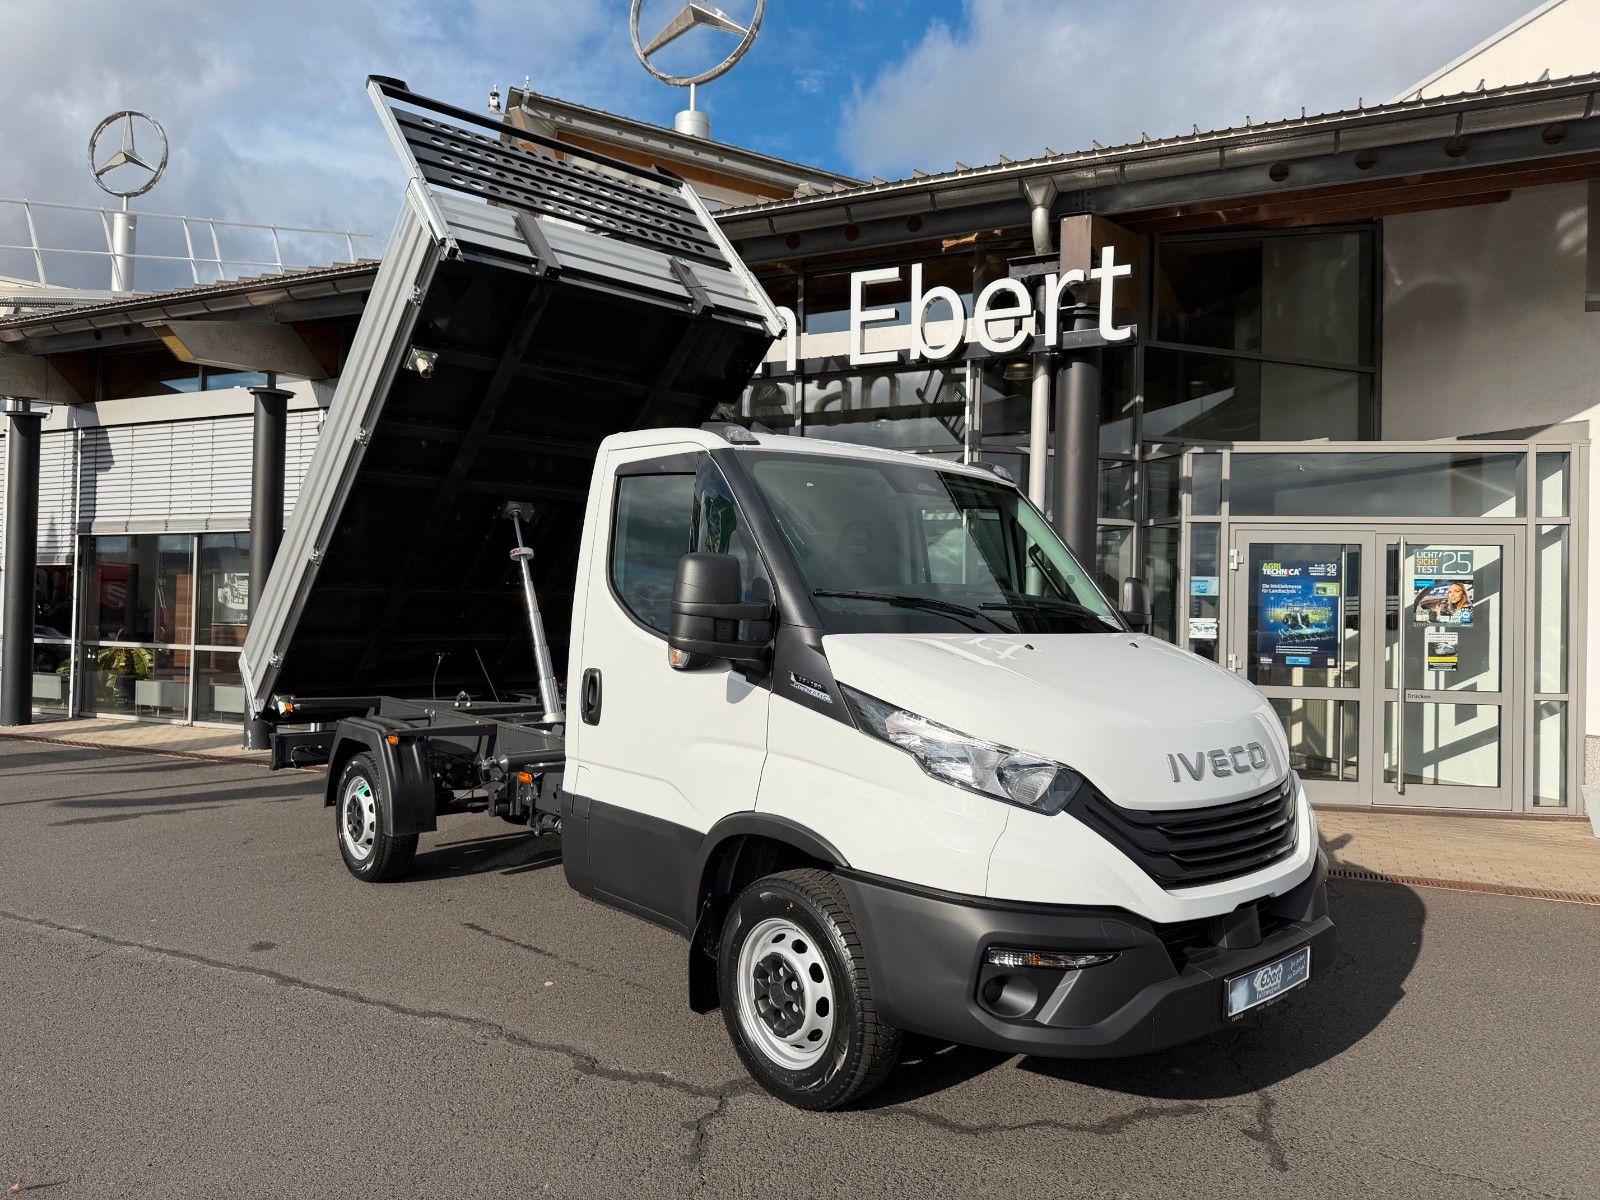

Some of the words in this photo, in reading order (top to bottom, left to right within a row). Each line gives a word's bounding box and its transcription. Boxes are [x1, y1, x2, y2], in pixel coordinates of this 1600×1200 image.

[850, 246, 1132, 366] Ebert
[1416, 551, 1439, 559] LICHT
[1416, 566, 1439, 574] TEST
[1166, 741, 1267, 783] IVECO
